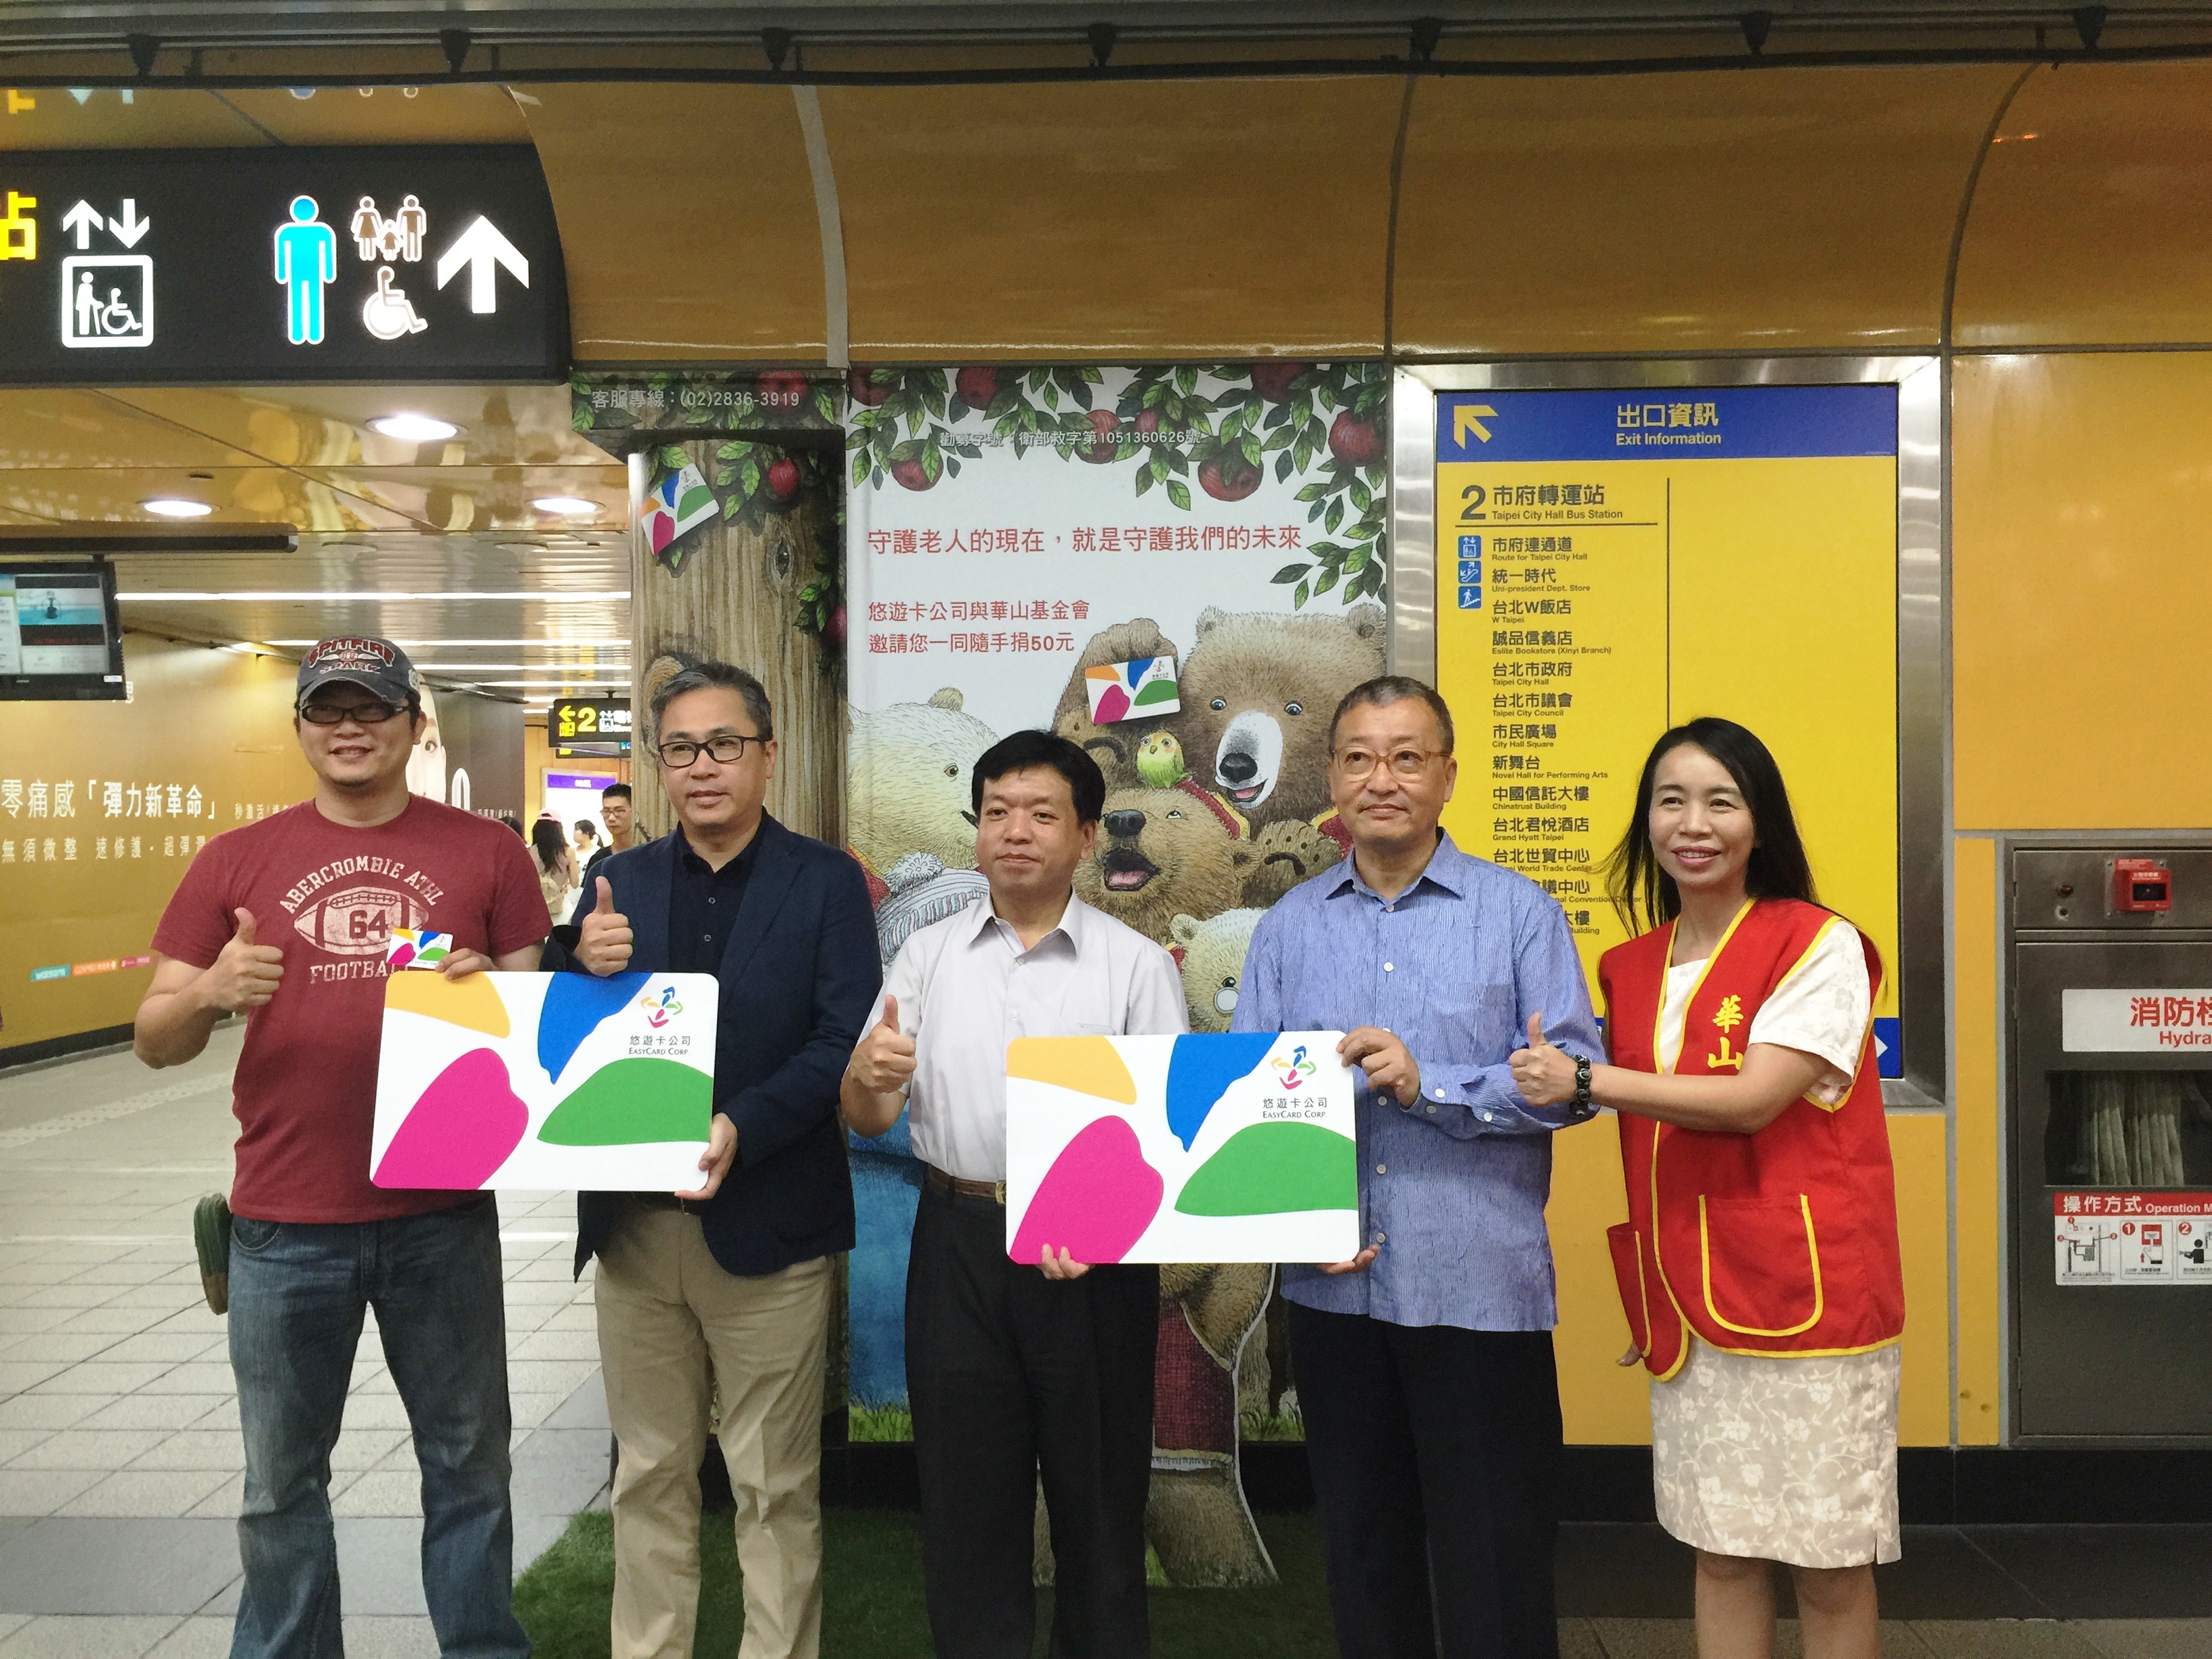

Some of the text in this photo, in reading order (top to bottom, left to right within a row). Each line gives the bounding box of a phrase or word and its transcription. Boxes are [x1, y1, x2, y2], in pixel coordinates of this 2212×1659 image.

[1617, 403, 1719, 428] 出口資訊
[1616, 432, 1722, 446] Exit Information
[1460, 485, 1486, 520] 2
[1492, 484, 1605, 506] 市府轉運站
[1492, 509, 1623, 521] Taipei City Hall Bus Station
[1492, 536, 1573, 552] 市府連通道
[1530, 554, 1553, 562] Taipei
[1555, 553, 1570, 562] City
[1492, 568, 1557, 584] 統一時代
[1492, 584, 1591, 593] Uni-president Dept. Store
[867, 599, 1090, 623] 悠遊卡公司與華山基金會
[1492, 599, 1572, 615] 台北W飯店
[1502, 616, 1525, 624] Taipei
[868, 631, 1076, 655] 邀請您一同隨手捐50元
[1492, 630, 1573, 647] 誠品信義店
[1557, 647, 1580, 655] (Xinyi
[1580, 646, 1612, 655] Branch)
[1492, 661, 1573, 677] 台北市政府
[1492, 678, 1515, 687] Taipei
[1516, 678, 1532, 687] City
[1492, 692, 1573, 708] 台北市議會
[577, 707, 597, 733] 2
[1492, 710, 1515, 718] Taipei
[1516, 710, 1532, 718] City
[1492, 724, 1557, 739] 市民廣場
[1526, 741, 1555, 749] Square
[1492, 754, 1540, 771] 新舞台
[1547, 771, 1591, 780] Performing
[1492, 785, 1590, 802] 中國信託大樓
[1535, 802, 1568, 811] Building
[1493, 817, 1590, 833] 台北君悅酒店
[1518, 834, 1540, 842] Hyatt
[1542, 834, 1565, 842] Taipei
[1493, 848, 1591, 863] 台北世貿中心
[279, 855, 405, 914] ABERCROMBIE
[349, 909, 389, 939] 64
[1707, 994, 1744, 1070] 華山
[629, 1035, 691, 1046] 悠遊卡公司
[1263, 1097, 1327, 1109] 悠遊卡公司
[2063, 1195, 2142, 1213] 操作方式
[2145, 1203, 2201, 1215] Operation
